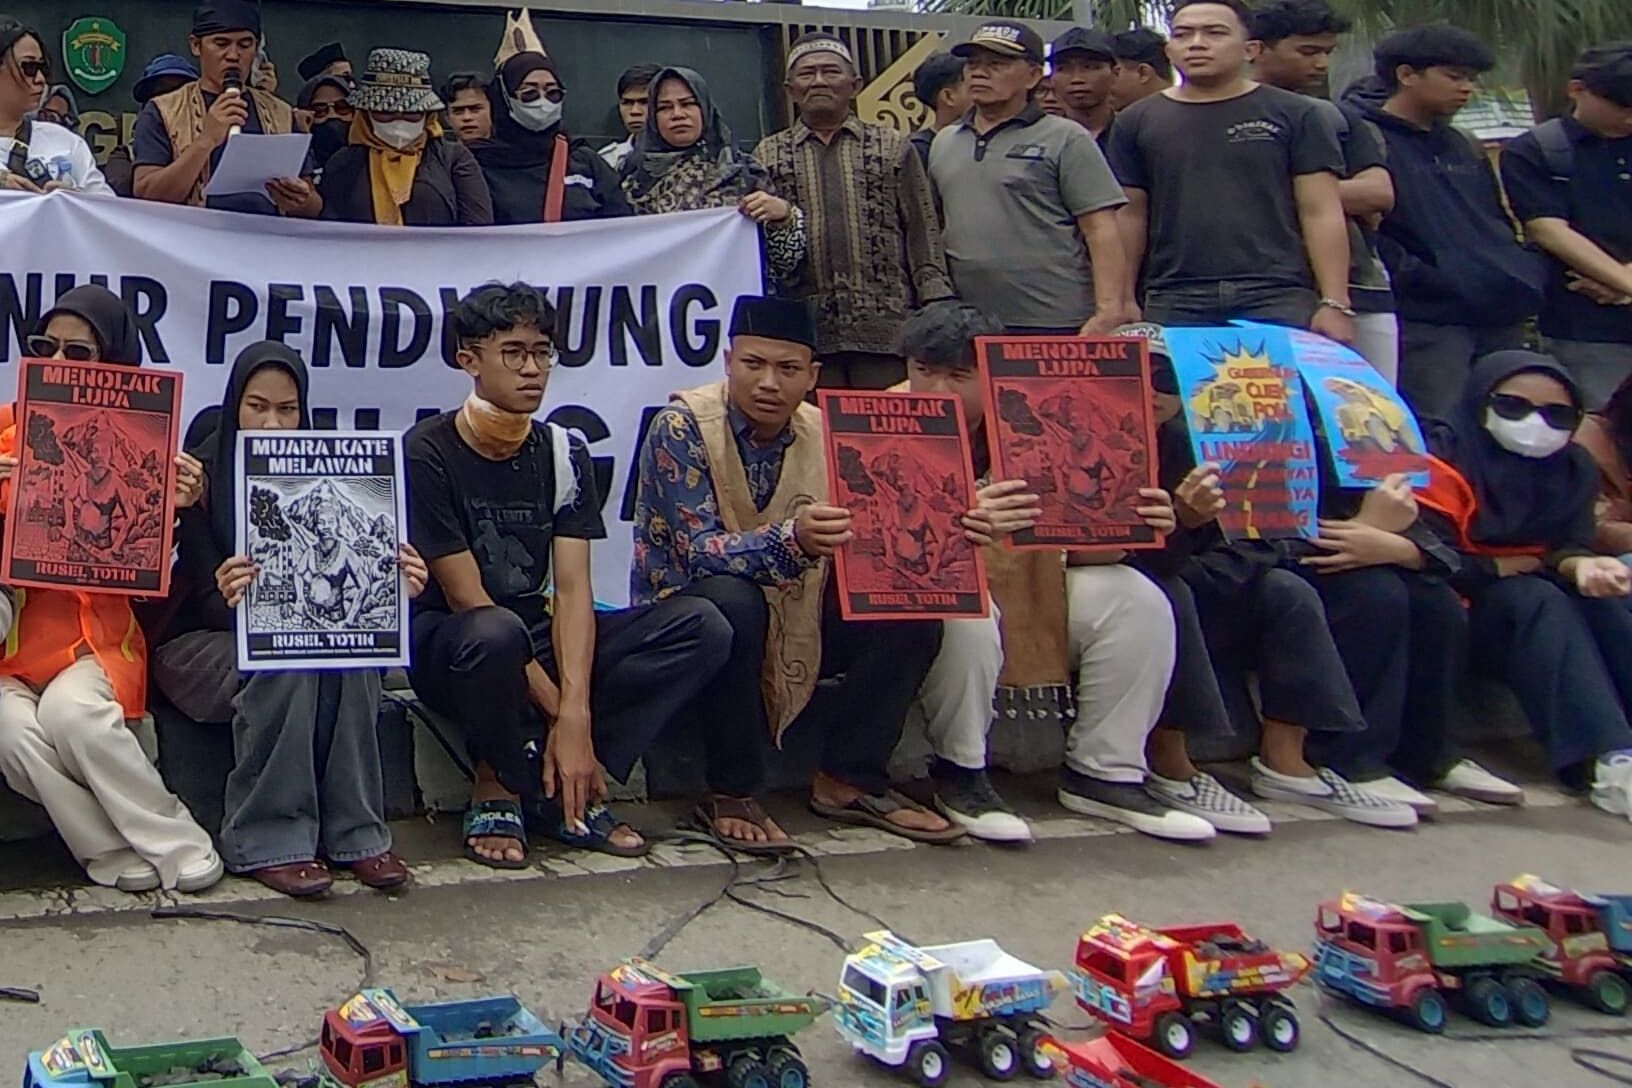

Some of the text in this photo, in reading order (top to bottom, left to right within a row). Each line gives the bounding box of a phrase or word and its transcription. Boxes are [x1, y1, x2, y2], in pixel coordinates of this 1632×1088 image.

[1003, 343, 1128, 360] MENOLAK
[1038, 360, 1101, 377] LUPA
[42, 366, 161, 394] MENOLAK
[72, 388, 130, 408] LUPA
[840, 397, 946, 417] MENOLAK
[870, 415, 922, 433] LUPA
[252, 439, 389, 456] MUARA KATE
[268, 458, 373, 474] MELAWAN
[35, 562, 87, 578] RUSEL
[92, 566, 136, 582] TOTIN
[272, 633, 375, 648] RUSEL TOTIN
